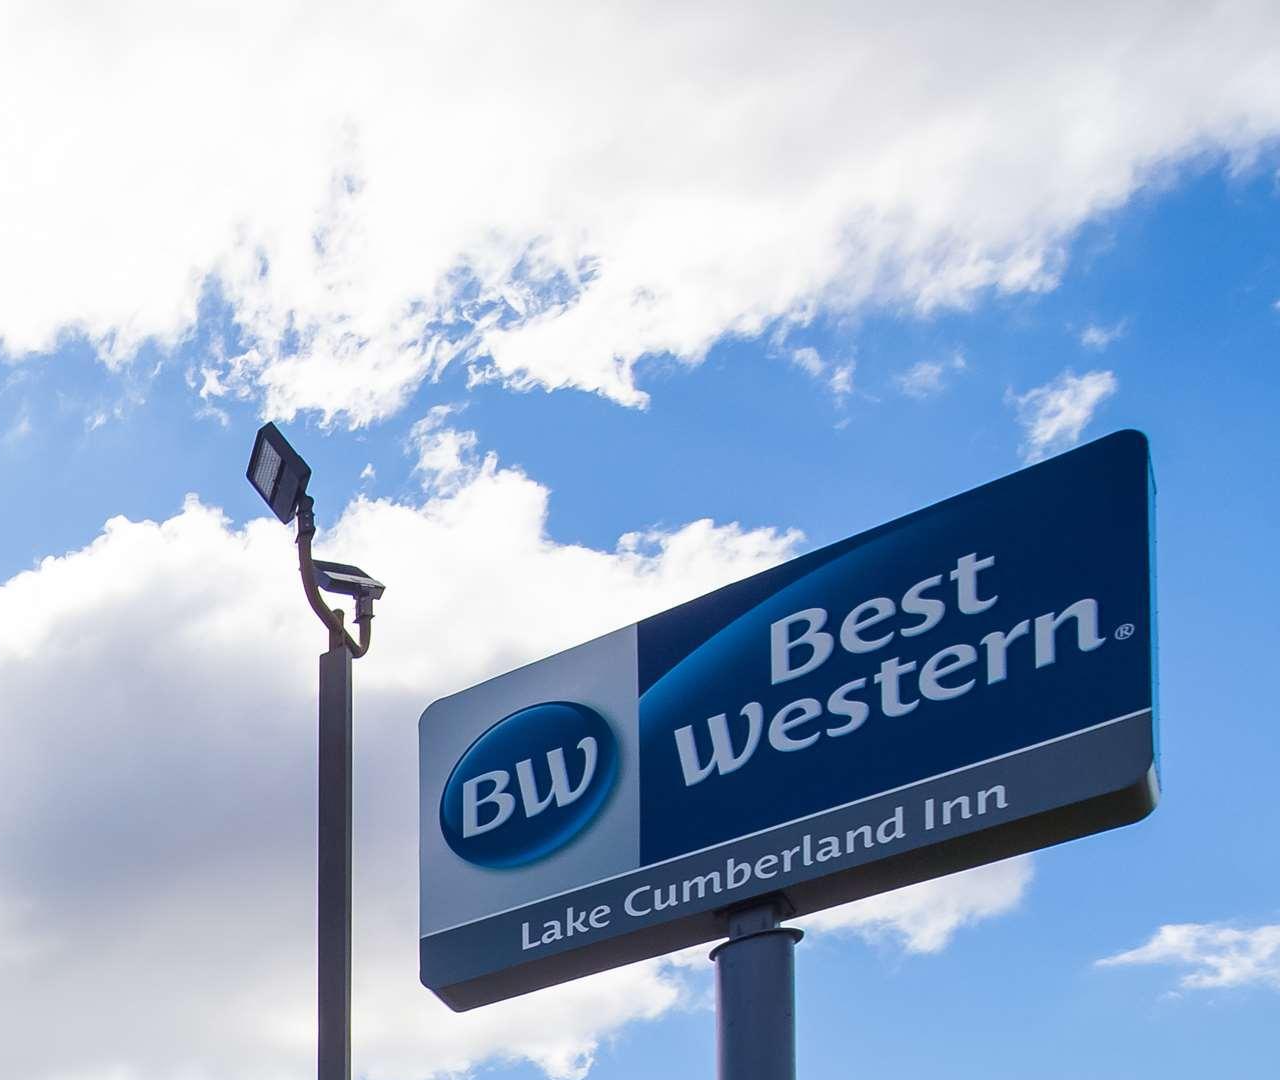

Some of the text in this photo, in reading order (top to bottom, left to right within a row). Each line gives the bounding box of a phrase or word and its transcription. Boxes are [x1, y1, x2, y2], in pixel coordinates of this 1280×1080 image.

[674, 598, 1106, 787] Western
[770, 552, 998, 685] Best
[461, 736, 598, 840] BW
[521, 784, 1009, 951] Lake Cumberland Inn
